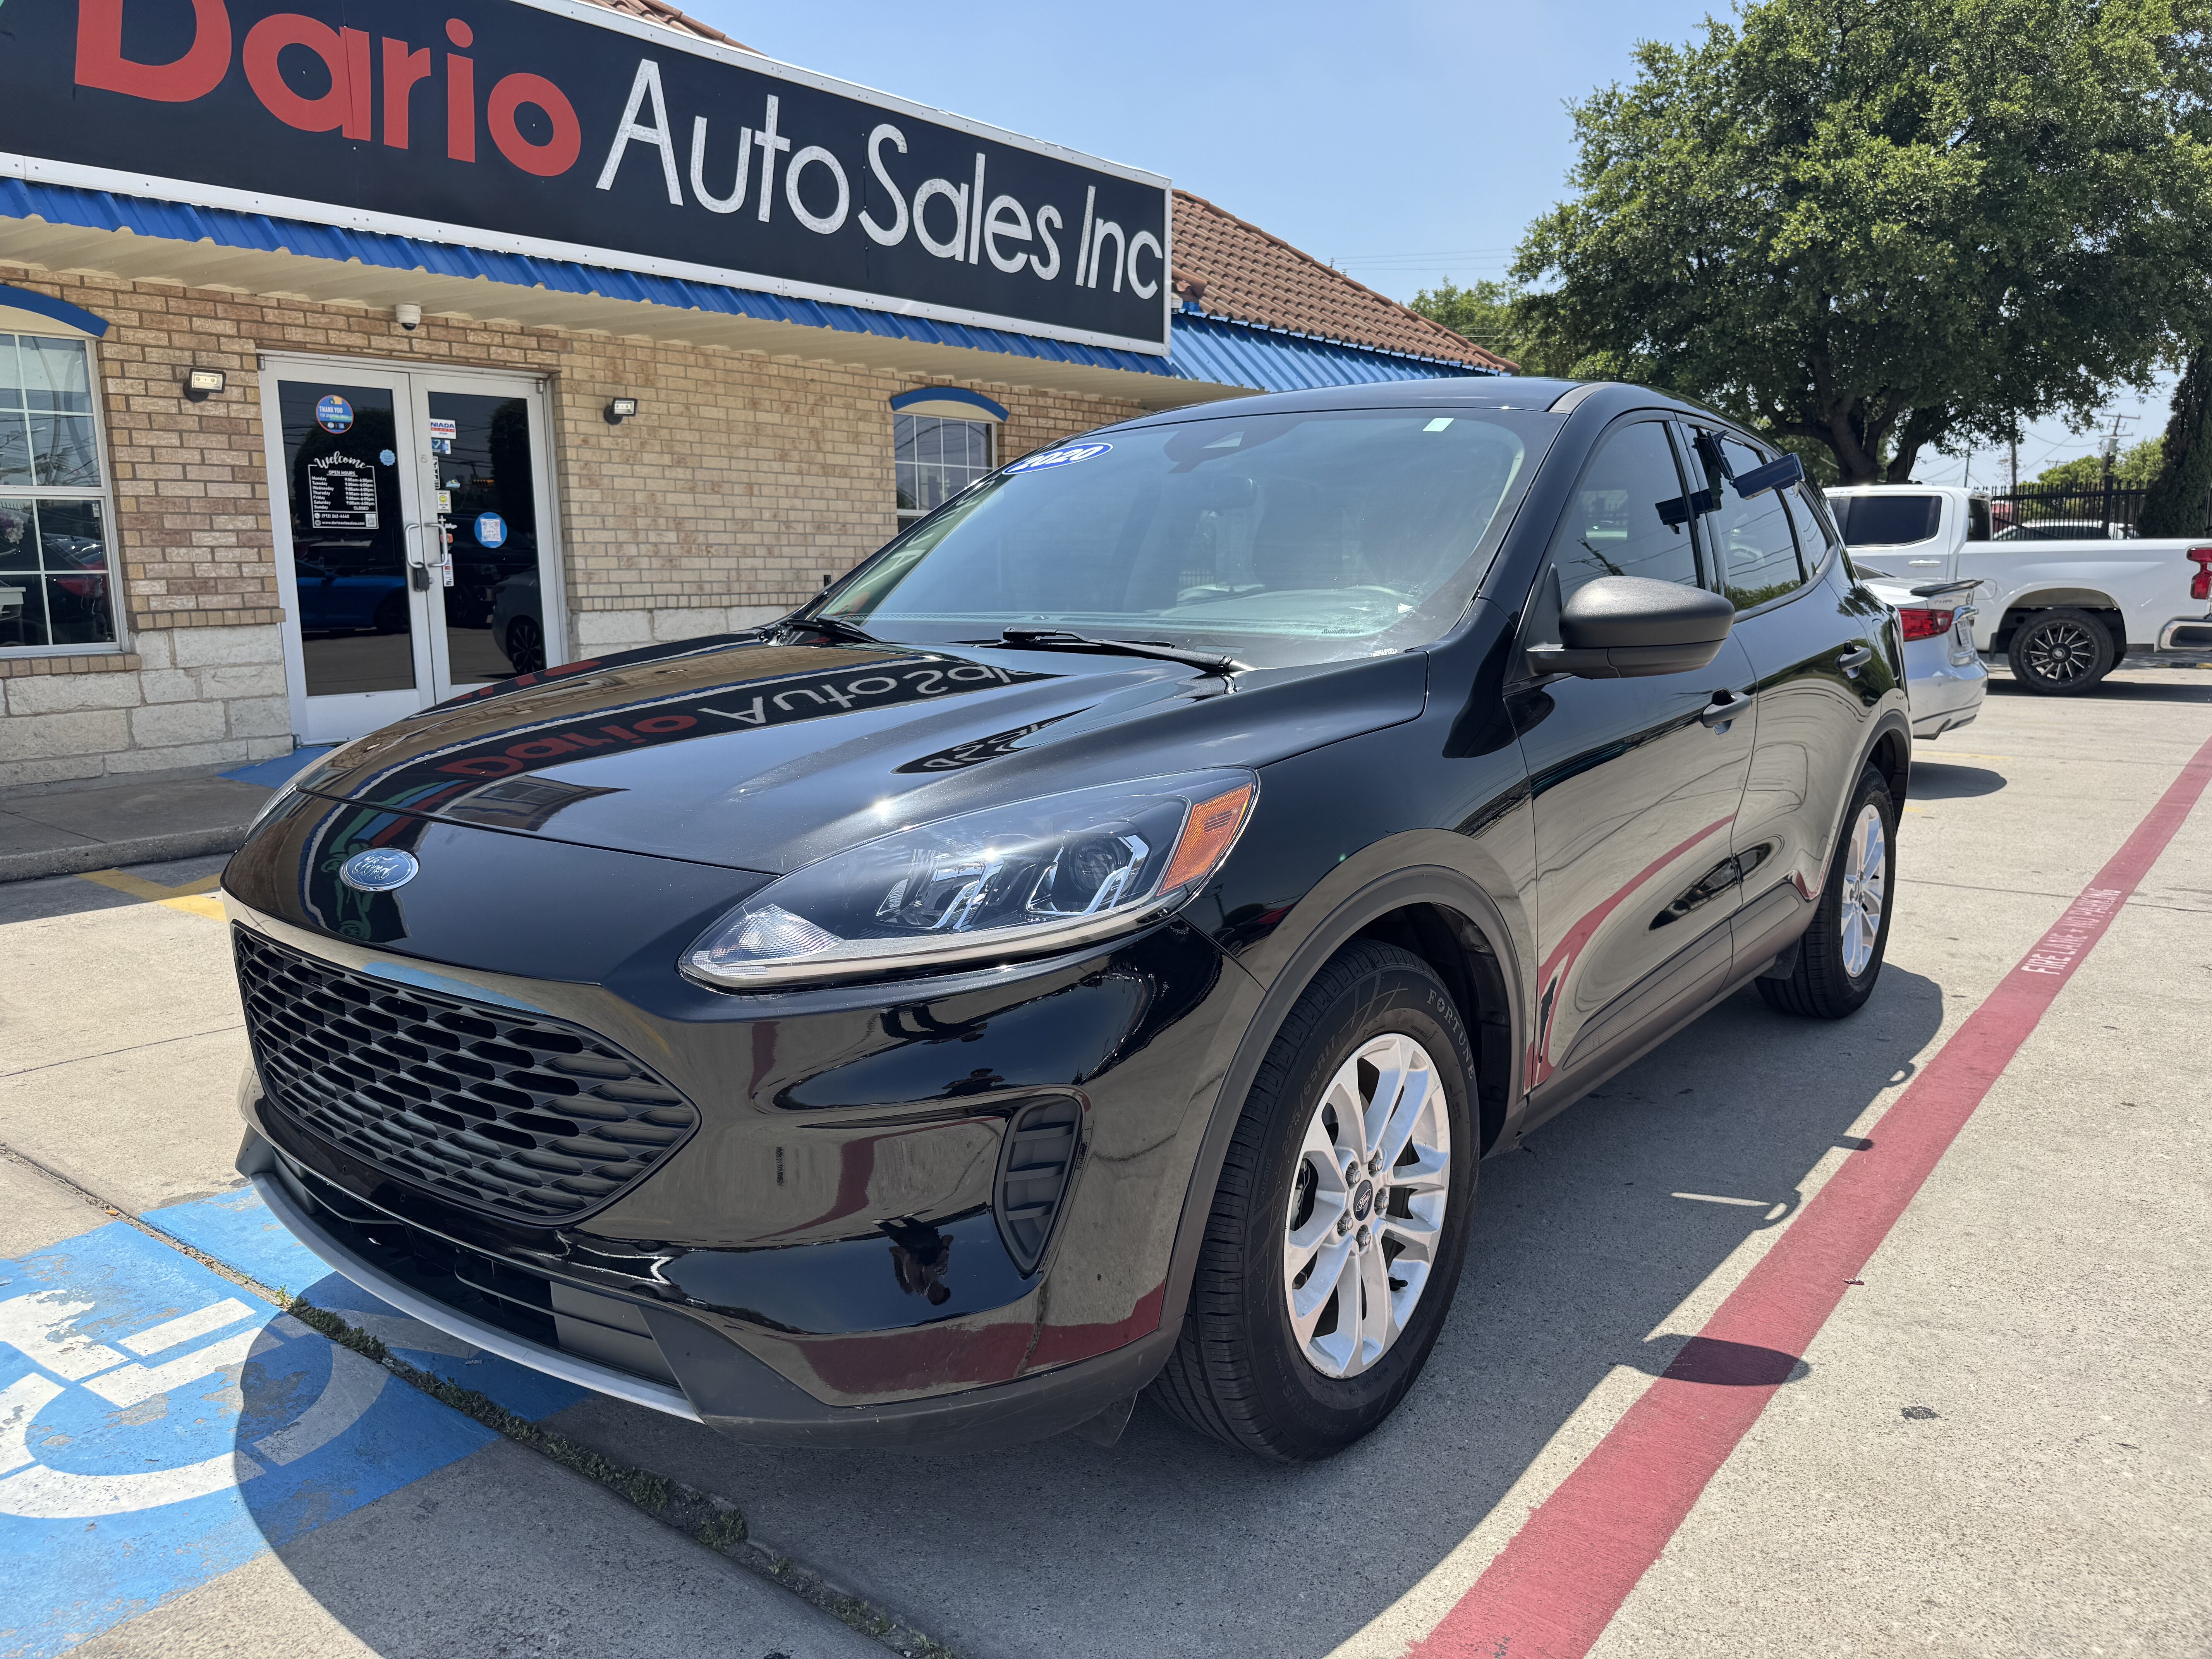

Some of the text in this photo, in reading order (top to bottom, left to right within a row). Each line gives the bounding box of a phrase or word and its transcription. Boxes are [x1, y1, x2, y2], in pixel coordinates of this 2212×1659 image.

[75, 0, 581, 176] Dario
[1075, 185, 1163, 299] Inc
[314, 451, 367, 469] Welcome
[1007, 446, 1104, 472] 2020
[352, 854, 399, 880] Ford
[2020, 888, 2123, 975] FIRE LANE NO PARKING
[1427, 988, 1475, 1079] FORTUNE
[1281, 1033, 1335, 1156] 225/65R17
[1259, 1154, 1273, 1201] OUTSIDE
